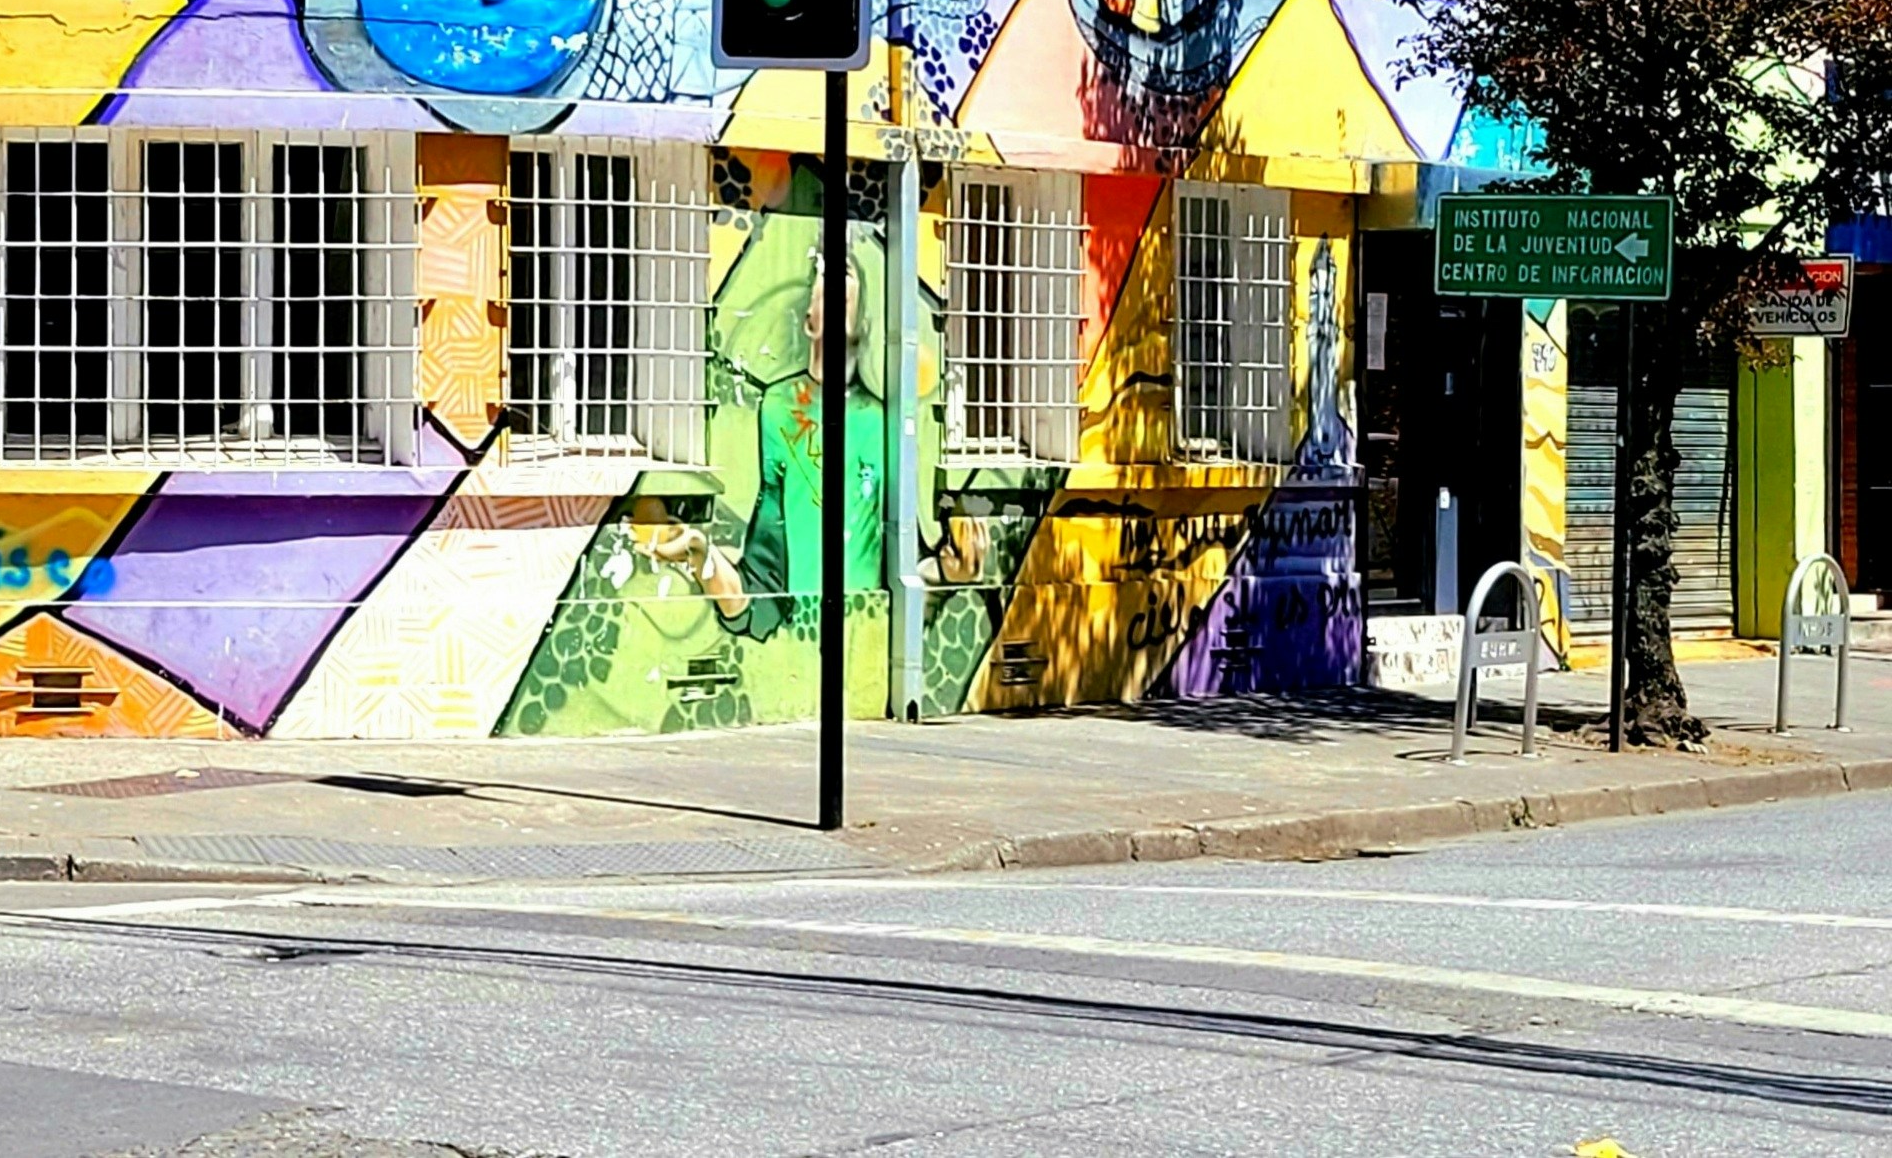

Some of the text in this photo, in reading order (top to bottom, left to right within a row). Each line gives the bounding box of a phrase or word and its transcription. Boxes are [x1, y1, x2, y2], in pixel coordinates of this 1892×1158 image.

[1454, 209, 1654, 230] INSTITUTO NACIONAL
[1453, 234, 1612, 255] DE LA JUVENTUD
[1442, 263, 1664, 285] CENTRO DE INFORMACION
